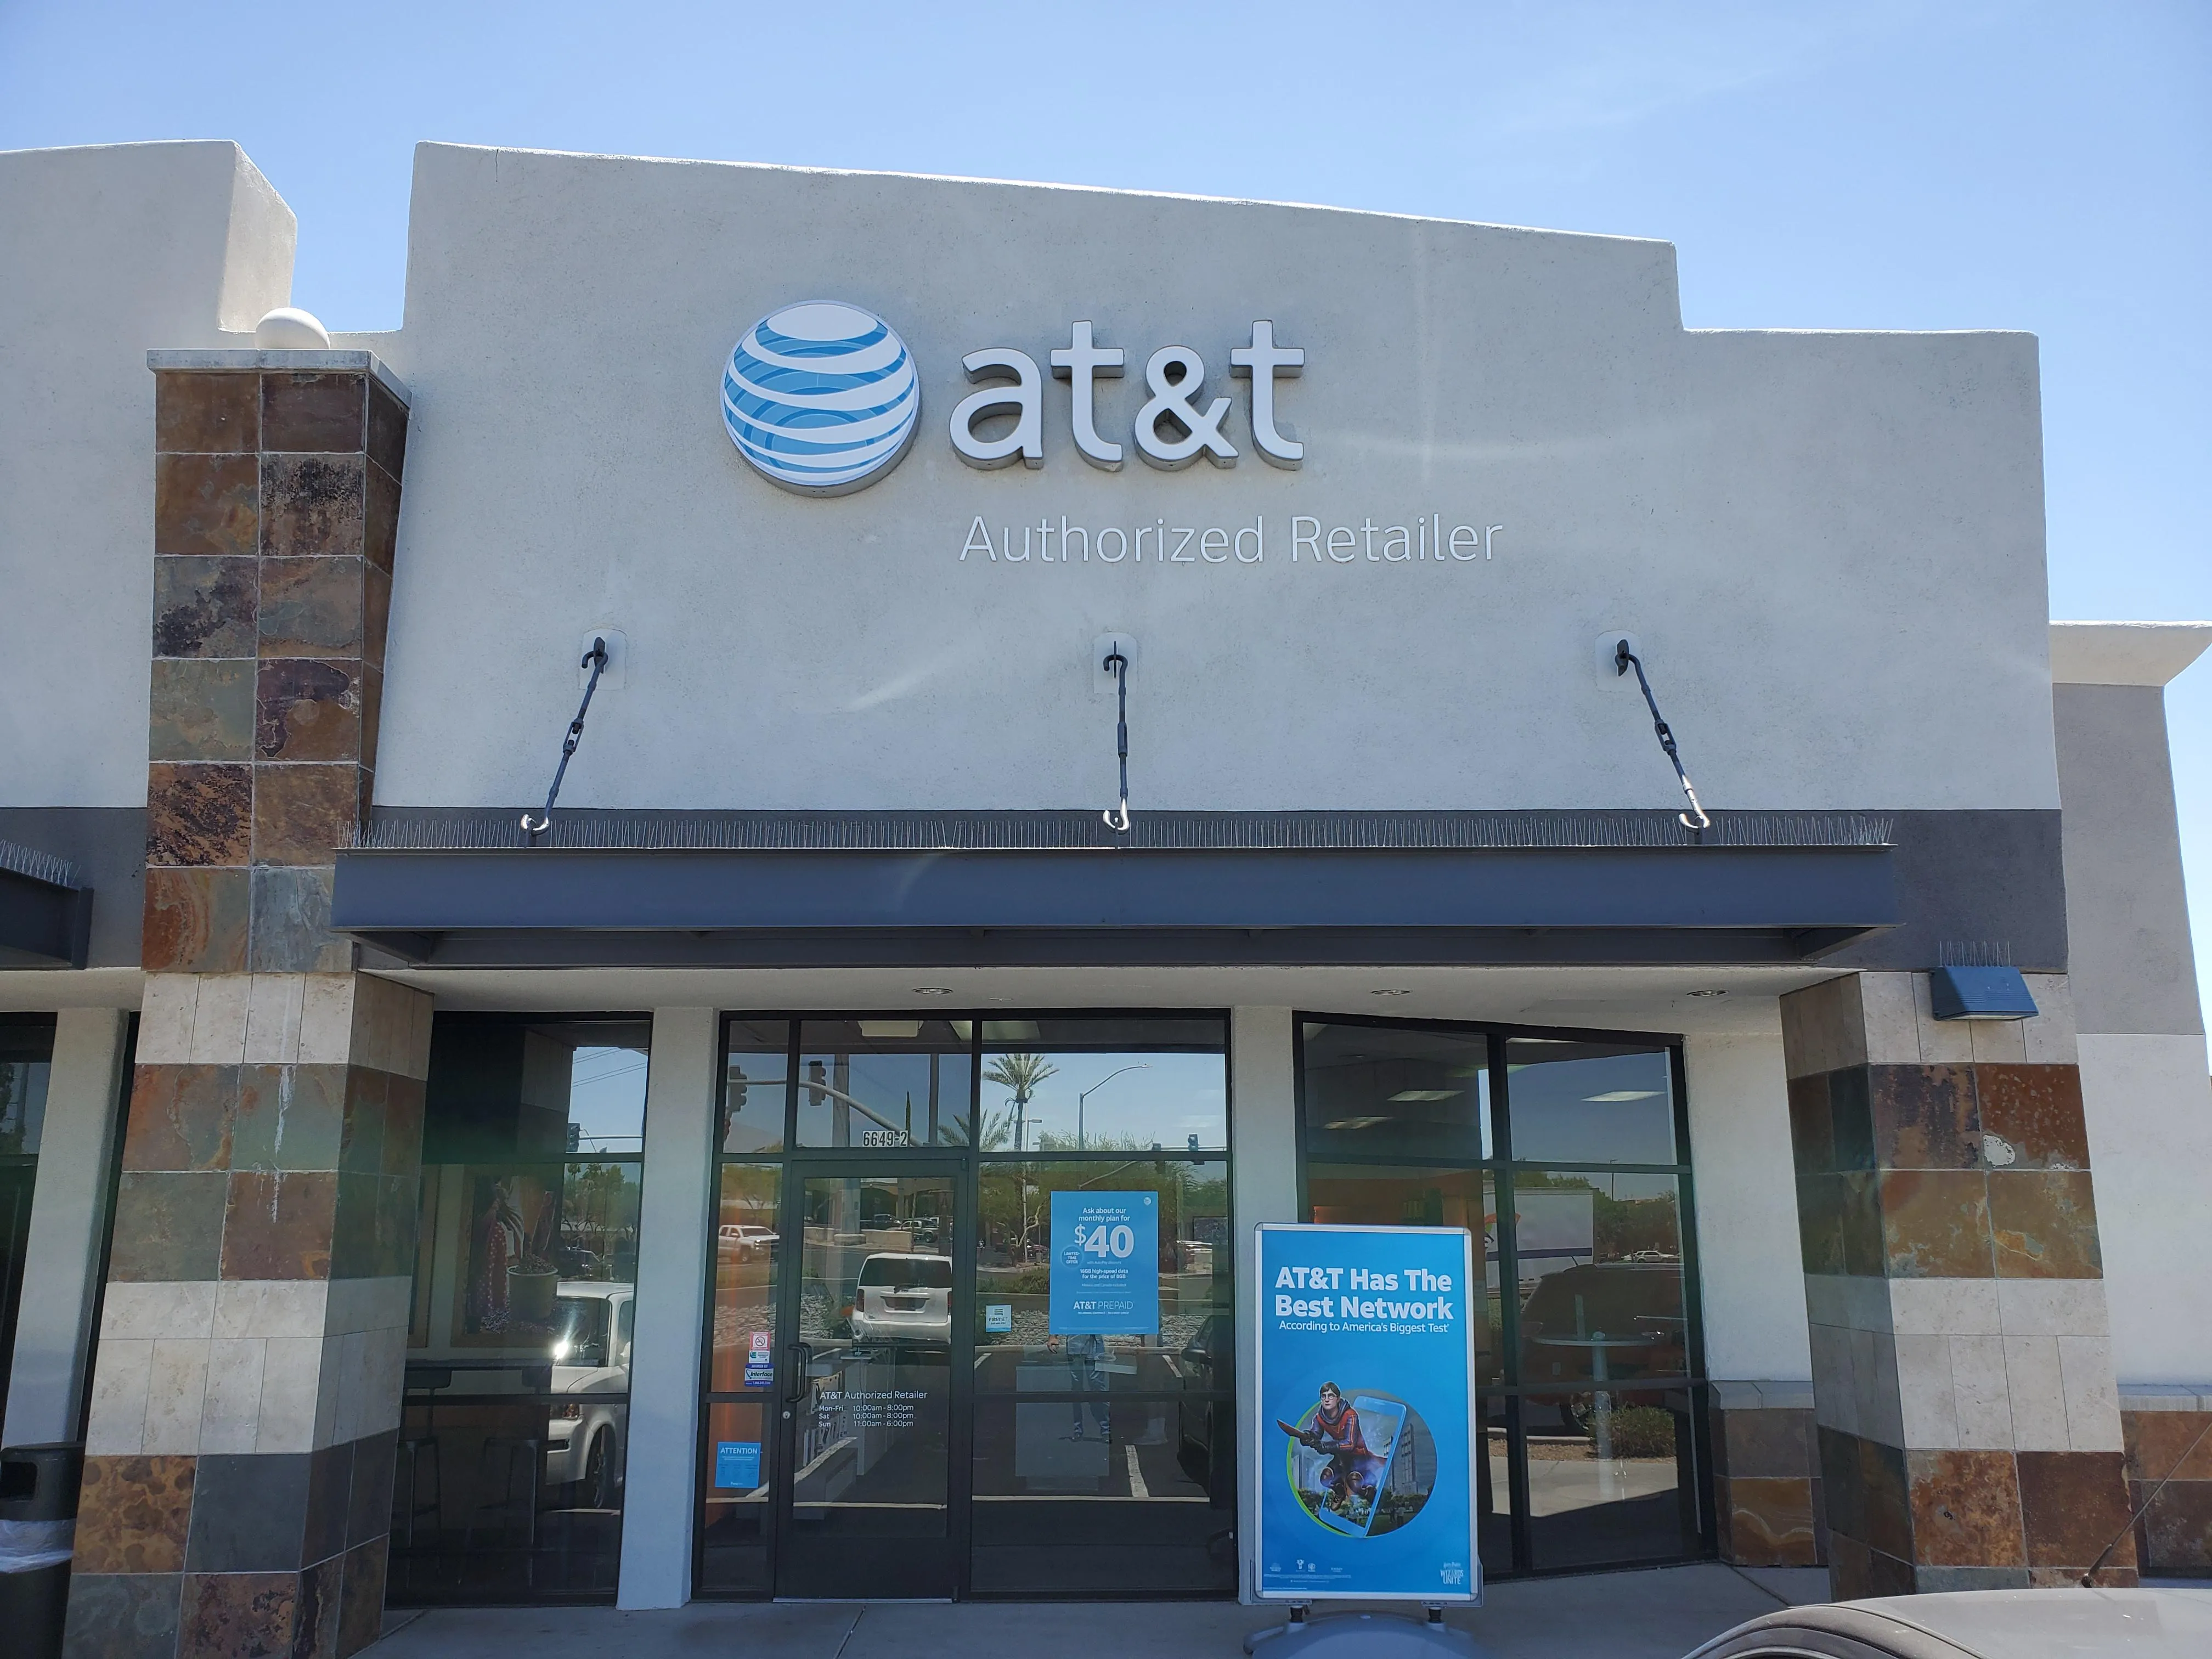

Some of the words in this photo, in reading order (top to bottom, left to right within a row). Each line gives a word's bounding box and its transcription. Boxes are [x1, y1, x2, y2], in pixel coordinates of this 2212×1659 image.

[949, 319, 1305, 471] at&t
[960, 514, 1265, 563] Authorized
[1290, 514, 1503, 563] Retailer
[863, 1131, 907, 1146] 6649-2
[1074, 1223, 1134, 1258] $40
[1275, 1266, 1344, 1290] AT&T
[1350, 1268, 1399, 1291] Has
[1404, 1268, 1453, 1292] The
[1073, 1301, 1097, 1310] AT&T
[1098, 1301, 1134, 1310] PREPAID
[1275, 1294, 1334, 1317] Best
[1341, 1295, 1454, 1319] Network
[1279, 1320, 1327, 1334] According
[1330, 1322, 1340, 1331] to
[1342, 1322, 1388, 1332] America's
[1390, 1322, 1426, 1335] Biggest
[820, 1391, 843, 1400] AT&T
[844, 1391, 893, 1400] Authorized
[894, 1391, 928, 1399] Retailer
[1443, 1575, 1462, 1585] UNITE
